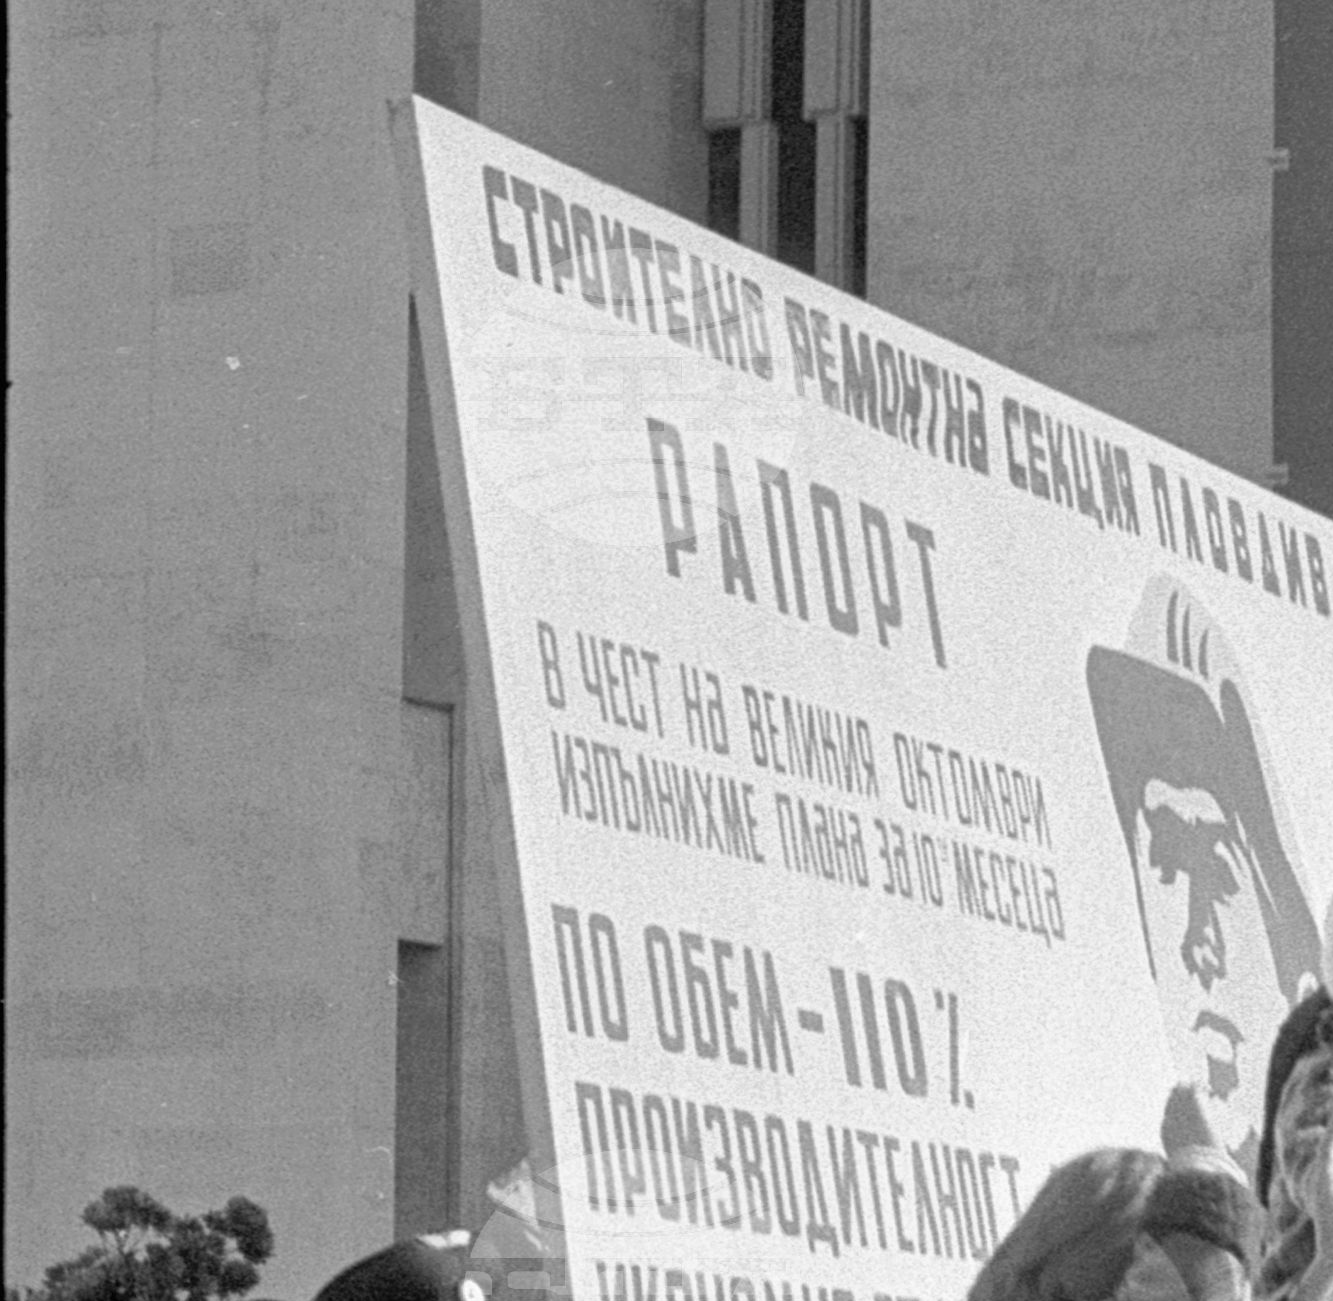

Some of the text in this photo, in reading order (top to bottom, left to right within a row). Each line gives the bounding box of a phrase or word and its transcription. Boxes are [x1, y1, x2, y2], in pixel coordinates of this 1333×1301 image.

[482, 164, 774, 382] СТРОИТЕЛНО
[1002, 396, 1140, 537] СЕКЦИЯ
[1148, 462, 1331, 618] ПЛОВДИВ
[646, 416, 949, 670] РАПОРТ
[537, 619, 566, 710] В
[575, 630, 665, 739] ЧЕСТ
[741, 684, 880, 801] ВЕЛИКИЯ
[892, 731, 1053, 851] ОКТОМВРИ
[550, 730, 766, 865] ИЗПЪЛНИХМЕ
[551, 903, 629, 1044] ПО
